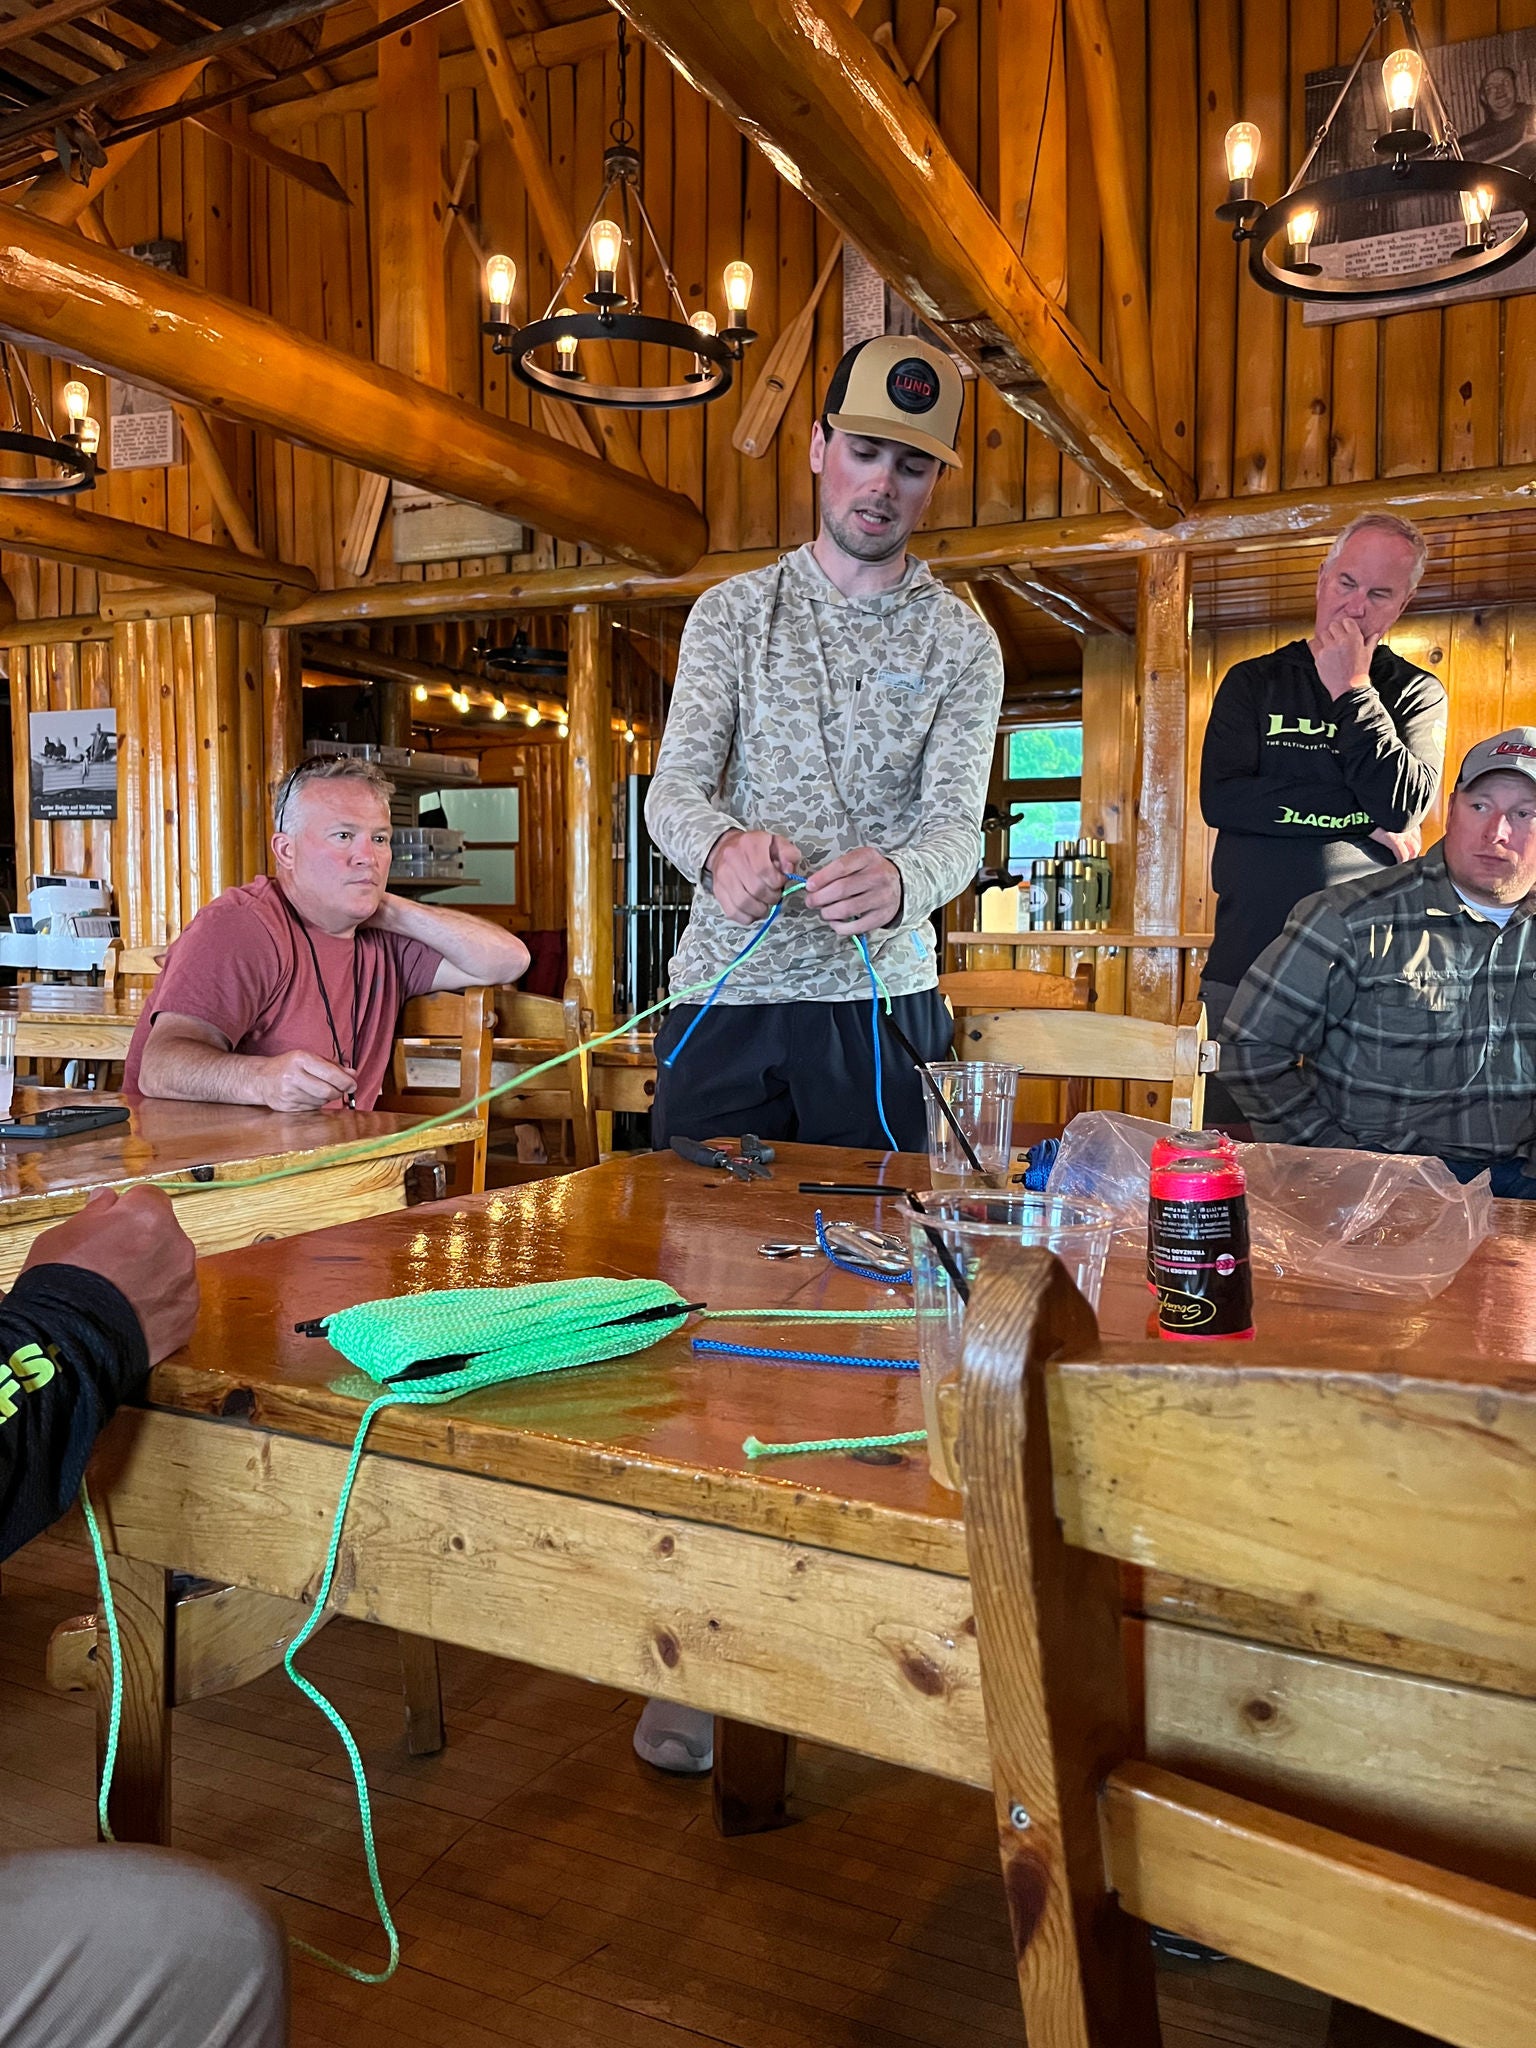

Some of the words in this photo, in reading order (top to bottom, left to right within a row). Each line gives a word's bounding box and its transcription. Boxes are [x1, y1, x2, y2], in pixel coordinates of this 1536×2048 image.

[895, 375, 932, 396] LUND
[1282, 740, 1318, 750] ULTIMATE
[1171, 1248, 1206, 1256] TRENZADO
